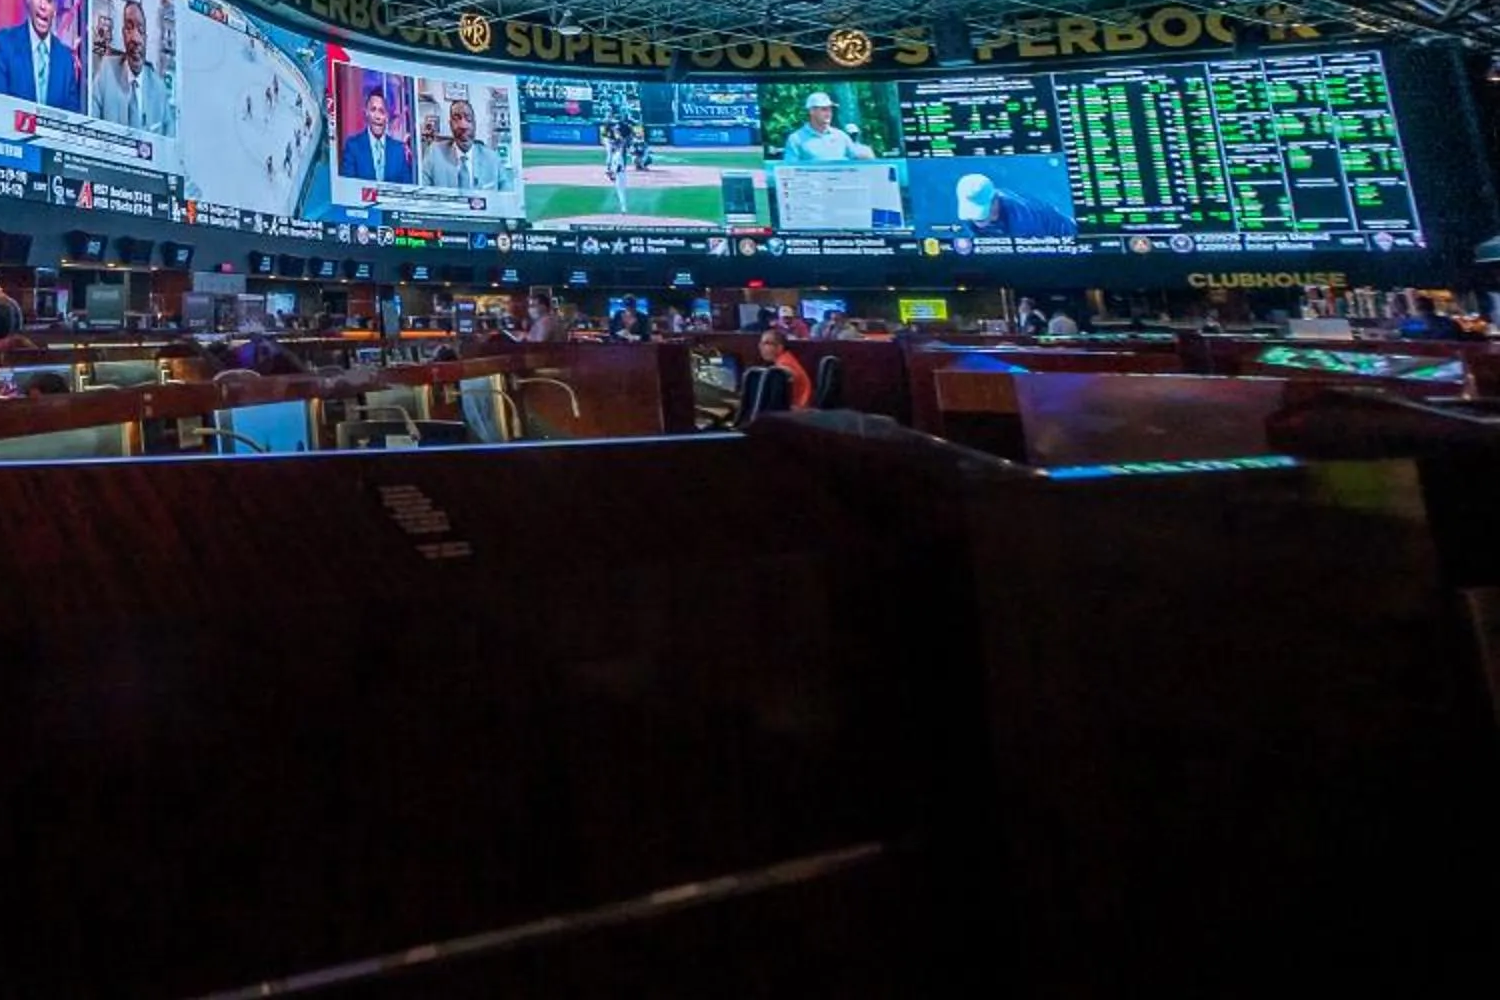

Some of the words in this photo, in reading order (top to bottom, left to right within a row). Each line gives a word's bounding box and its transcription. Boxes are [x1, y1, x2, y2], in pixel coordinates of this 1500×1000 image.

[895, 7, 1320, 65] SPERBOOK
[681, 103, 749, 116] WINTRUST
[1187, 272, 1348, 288] CLUBHOUSE
